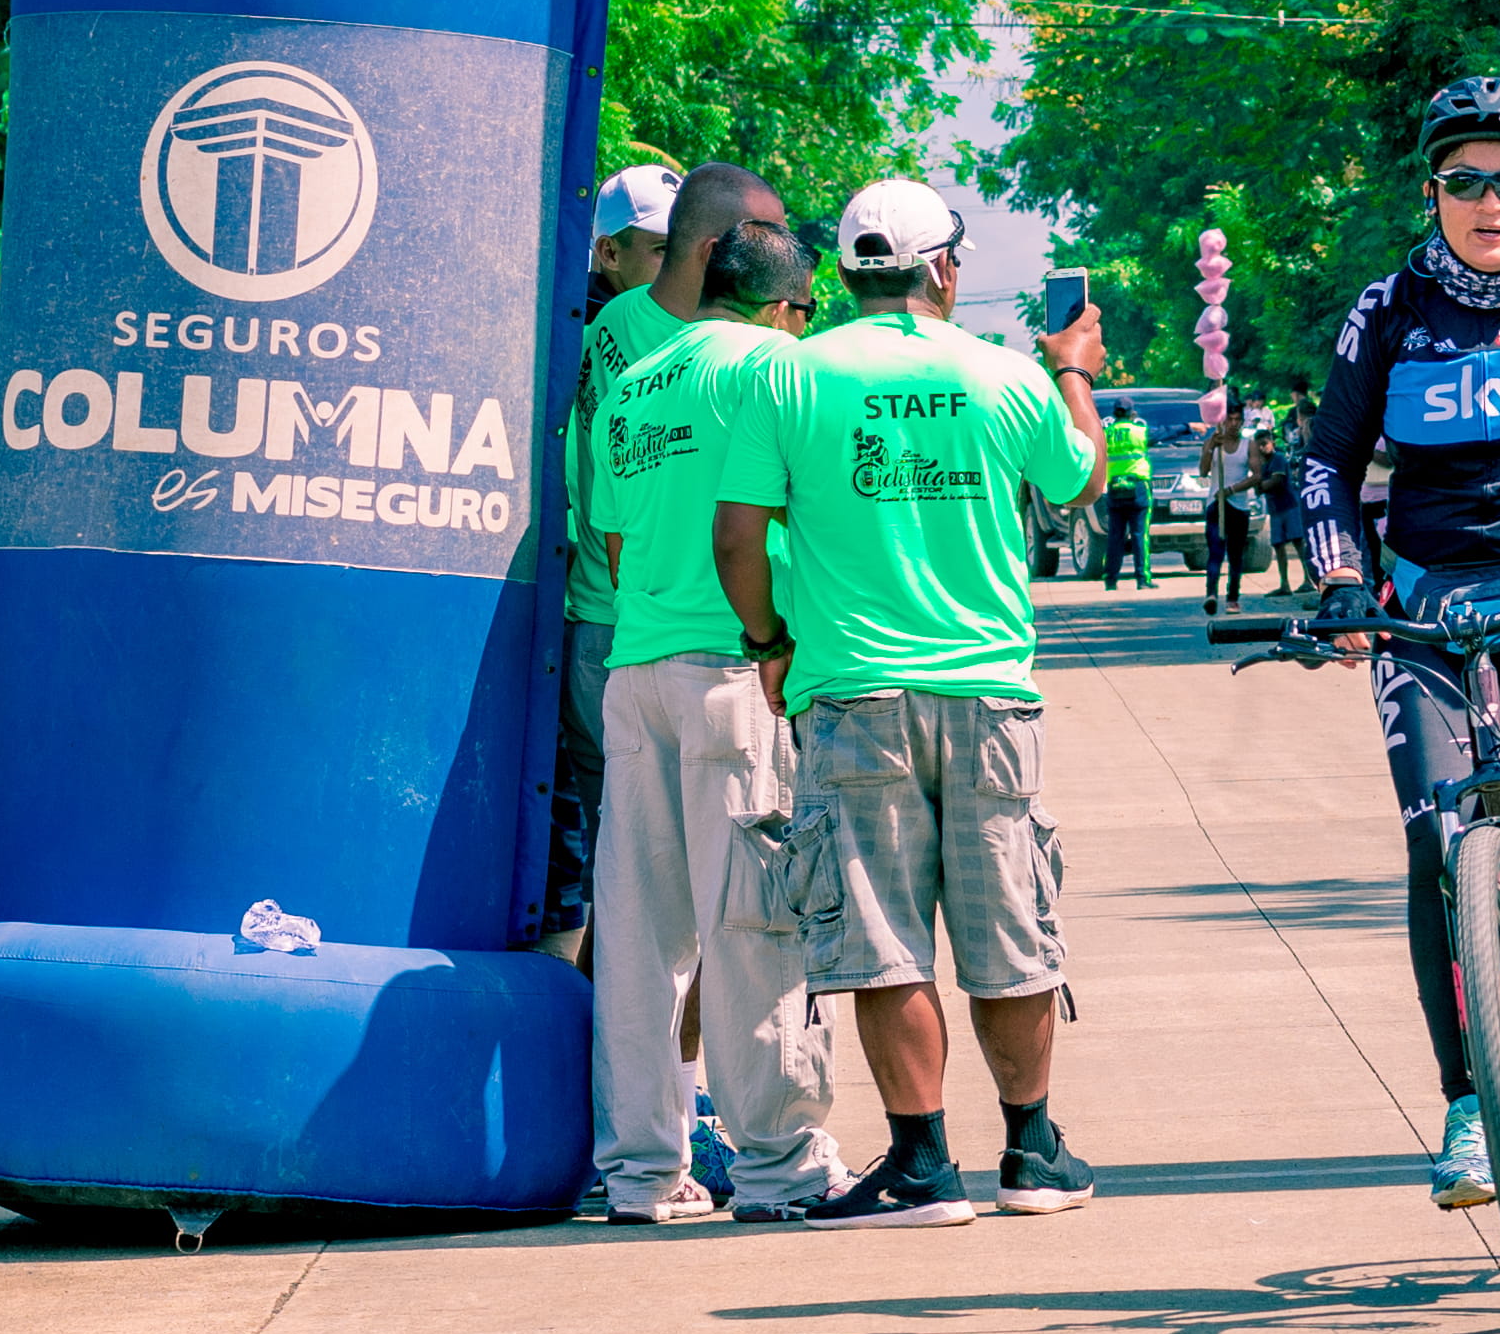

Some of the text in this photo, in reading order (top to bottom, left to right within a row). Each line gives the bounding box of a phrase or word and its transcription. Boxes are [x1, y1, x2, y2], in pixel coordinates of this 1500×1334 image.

[113, 310, 381, 362] SEGUROS
[619, 357, 693, 405] STAFF
[864, 392, 967, 420] STAFF
[2, 368, 515, 480] COLUMNA
[151, 467, 511, 534] es MISEGURO
[949, 471, 981, 486] 2018
[1301, 457, 1338, 510] sky
